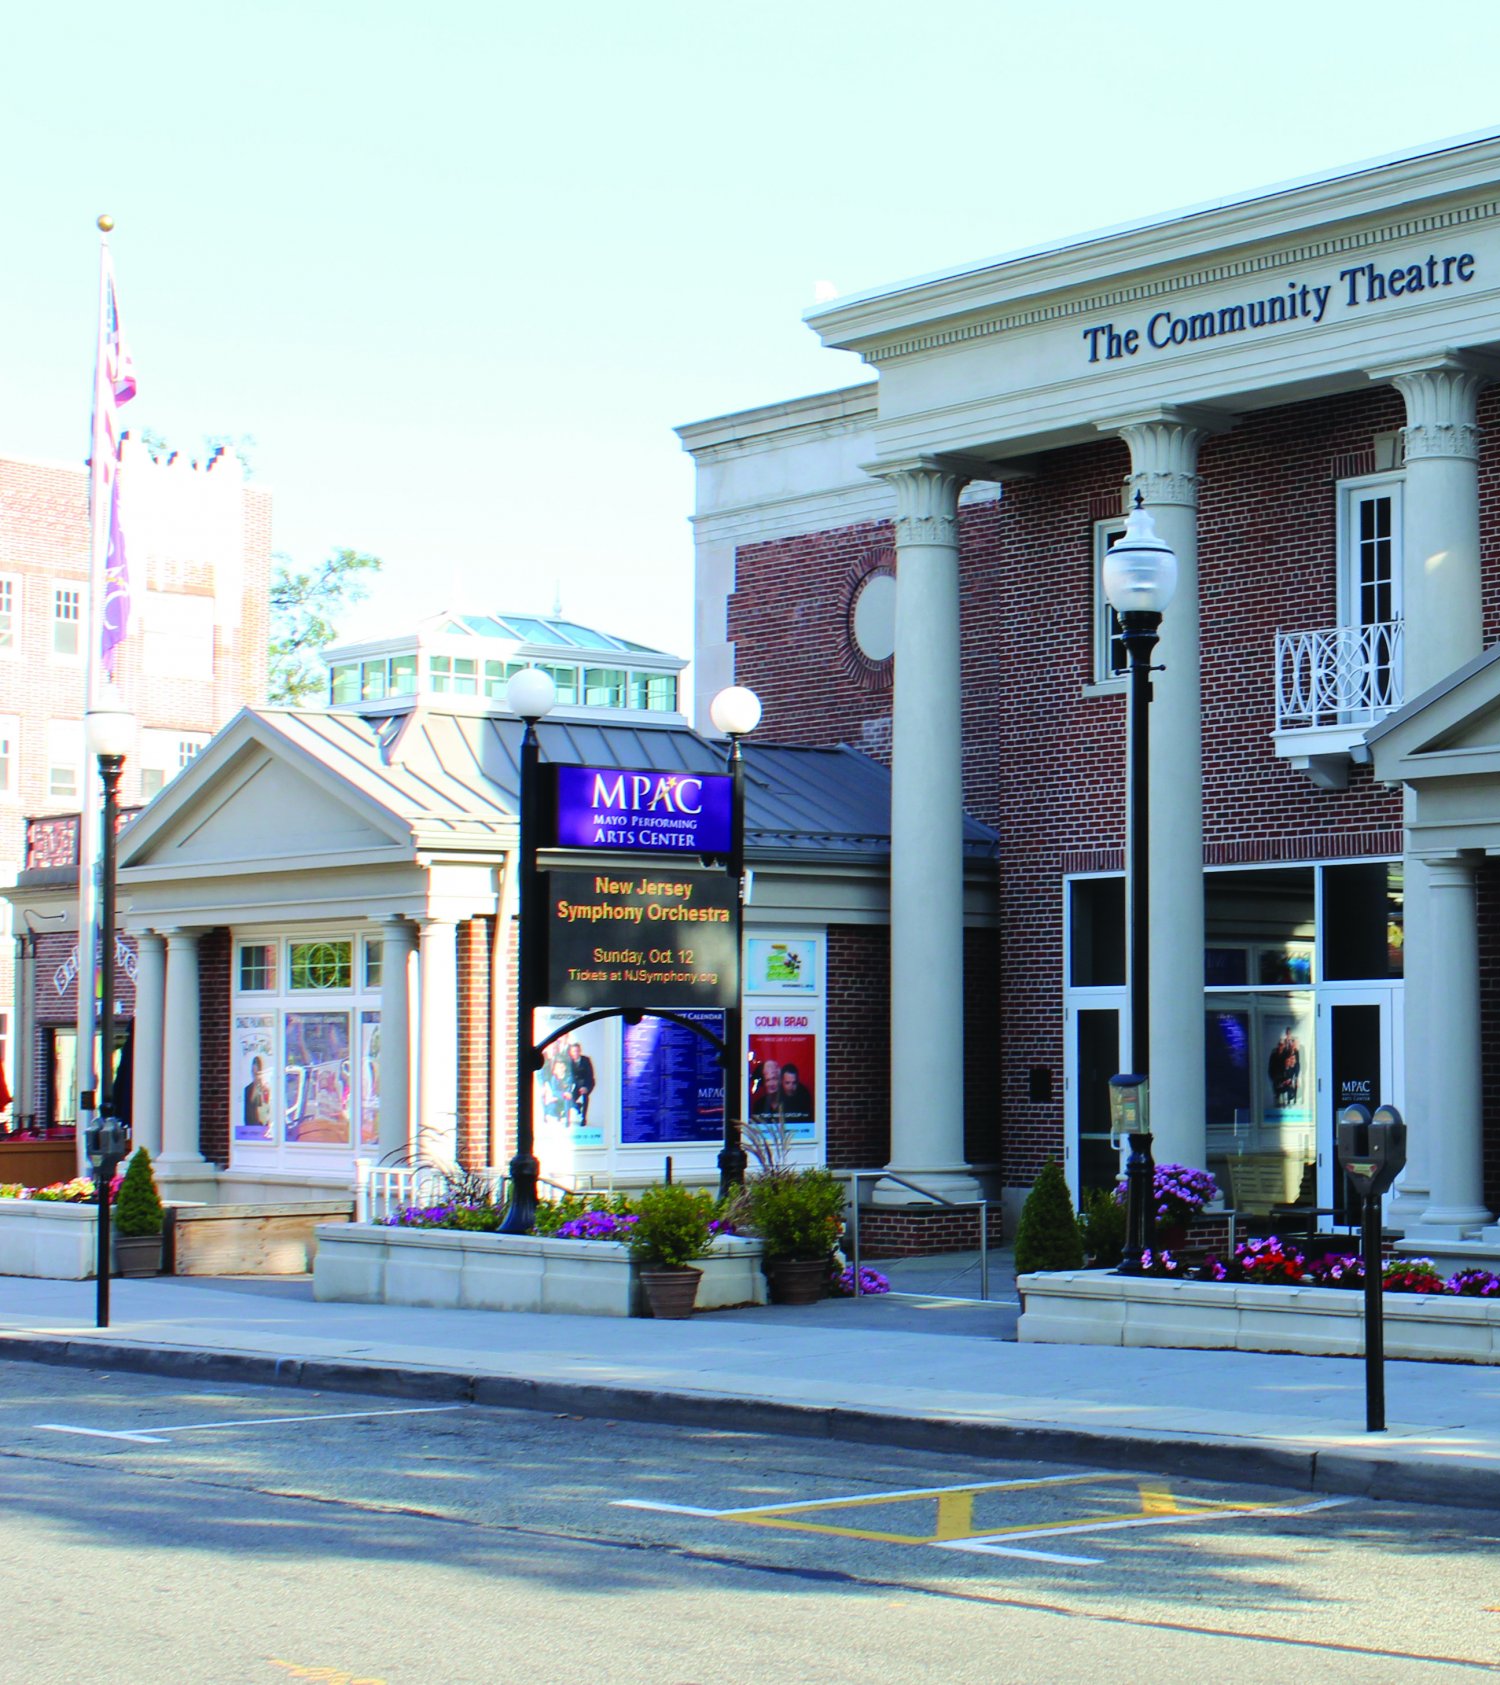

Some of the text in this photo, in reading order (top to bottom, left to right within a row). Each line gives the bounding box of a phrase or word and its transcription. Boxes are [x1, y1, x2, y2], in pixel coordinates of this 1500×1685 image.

[1083, 252, 1475, 363] The Community Theatre
[591, 773, 702, 814] MPAC
[593, 814, 697, 829] MAYO PERFORMING
[594, 828, 696, 847] ARTS CENTER
[594, 877, 693, 900] New Jersey
[557, 900, 730, 924] Symphony Orchestra
[593, 948, 694, 965] Sunday, Oct. 12
[568, 968, 718, 984] Tickets at NJSymphony.org
[755, 1016, 808, 1027] COLIN BRAD
[1342, 1080, 1370, 1092] MPAC
